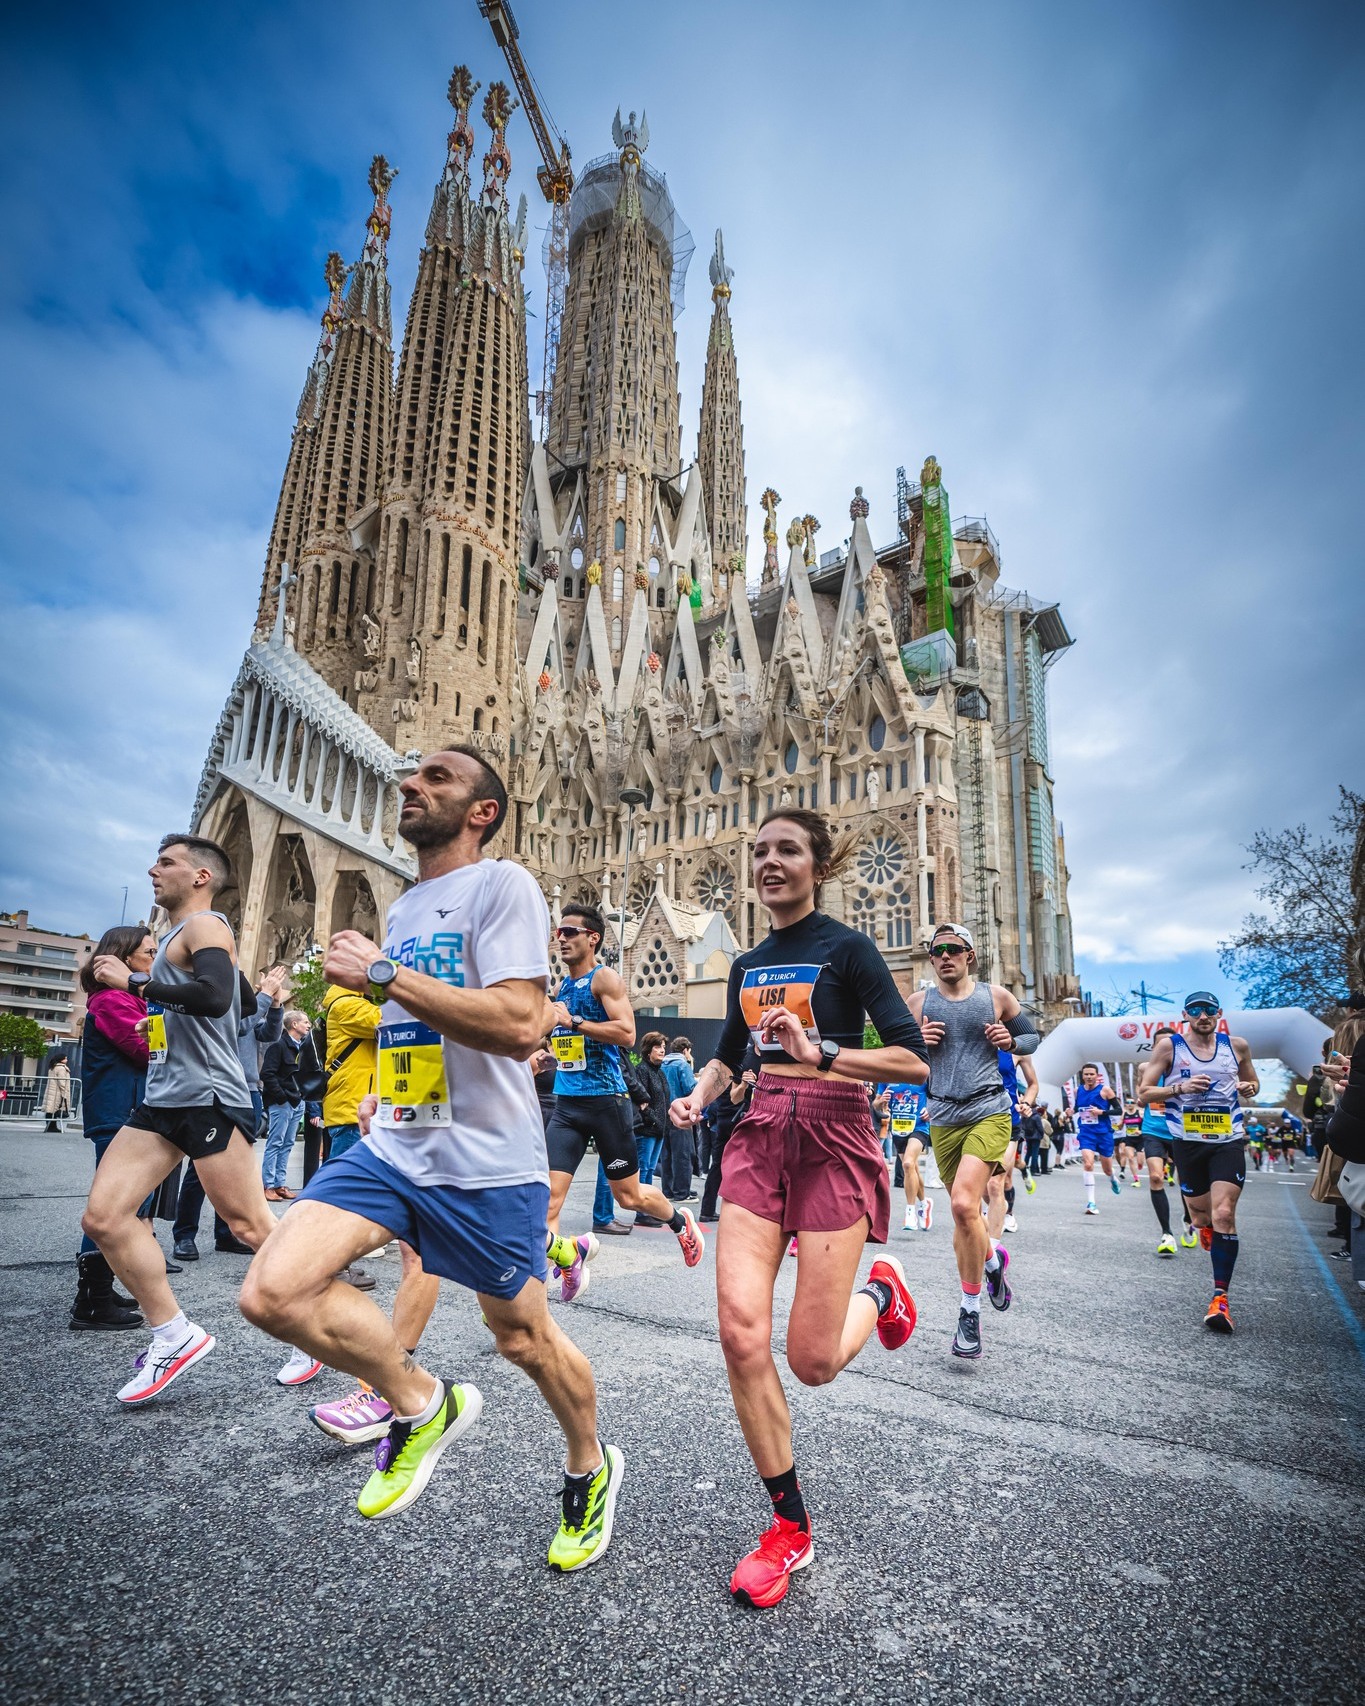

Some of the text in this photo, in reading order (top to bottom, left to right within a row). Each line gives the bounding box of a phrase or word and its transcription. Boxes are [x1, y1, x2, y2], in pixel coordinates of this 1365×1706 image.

[768, 972, 797, 981] ZURICH
[758, 987, 786, 1007] LISA
[393, 1031, 416, 1041] ZURICH
[1142, 1019, 1230, 1039] YAMA
[392, 1052, 412, 1074] TONI
[1190, 1114, 1224, 1124] ANTOINE
